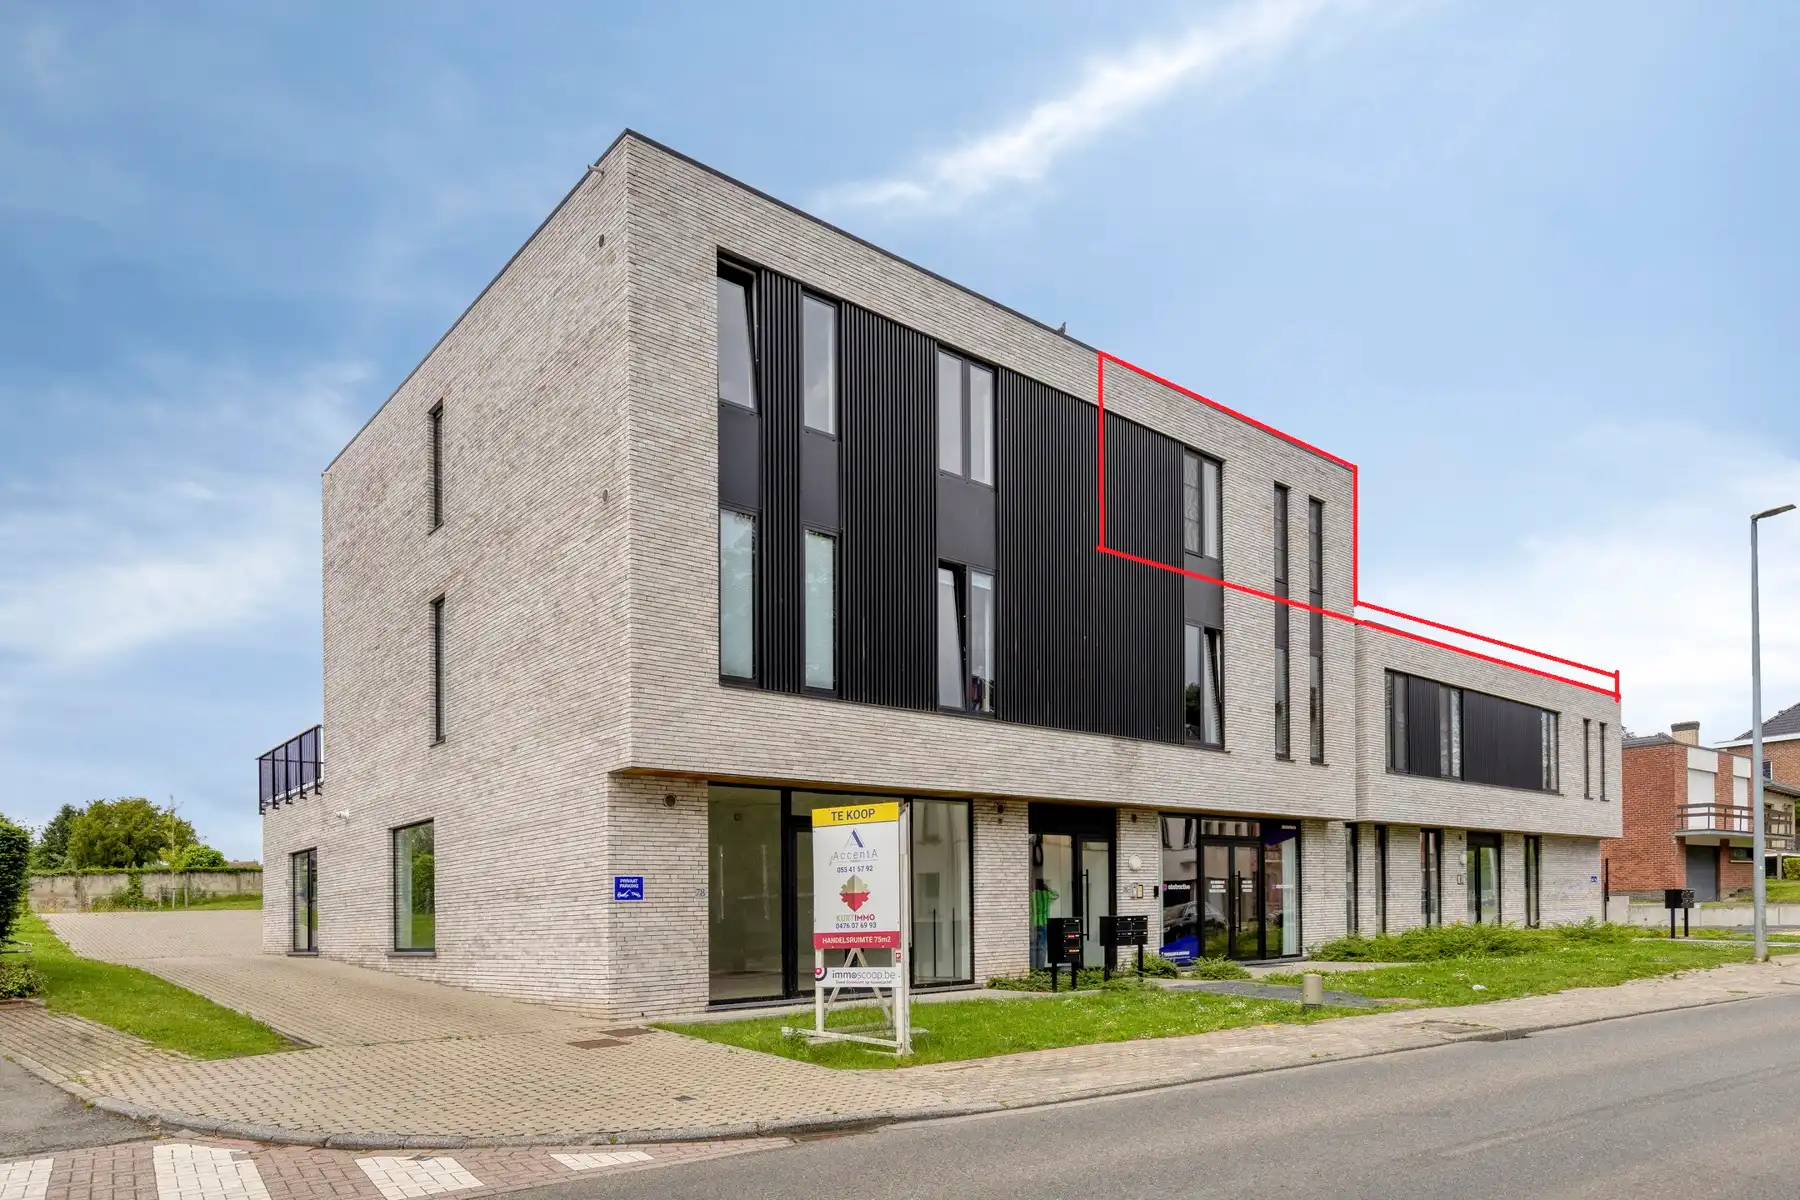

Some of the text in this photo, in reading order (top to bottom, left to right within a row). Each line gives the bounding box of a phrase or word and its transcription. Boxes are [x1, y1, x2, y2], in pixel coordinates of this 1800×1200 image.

[831, 808, 875, 821] TE KOOP
[832, 849, 878, 860] AccentA
[822, 936, 873, 944] HANDELSRUIMTE
[832, 969, 896, 980] immoscoop.be
